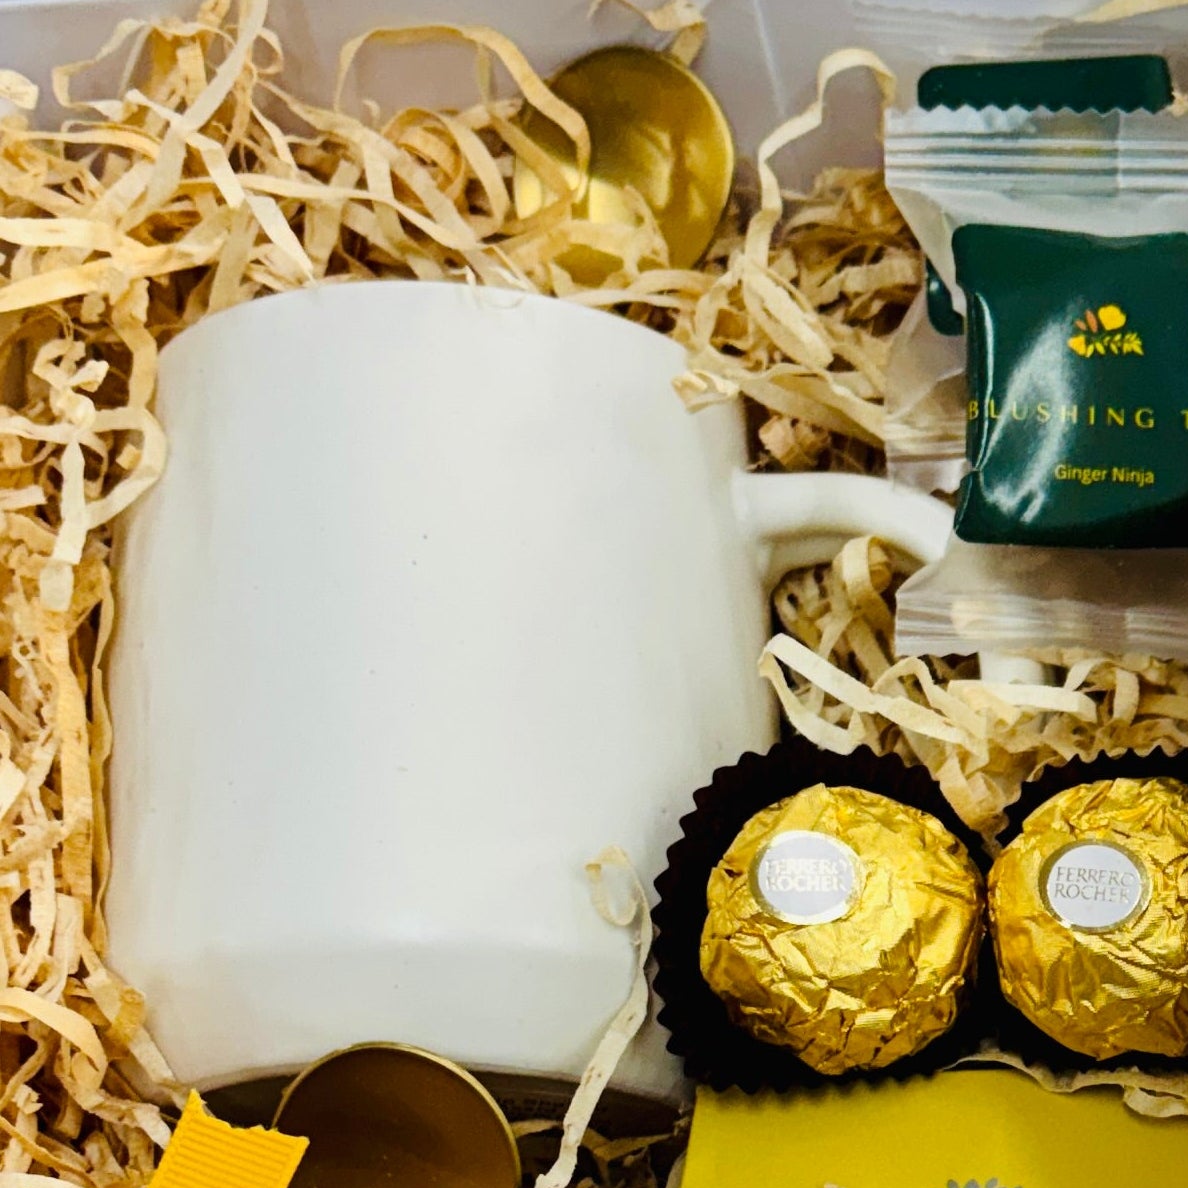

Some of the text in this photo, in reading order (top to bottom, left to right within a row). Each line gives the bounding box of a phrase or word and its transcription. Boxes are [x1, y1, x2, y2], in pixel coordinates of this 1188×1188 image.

[967, 399, 1156, 430] BLUSHING
[1054, 464, 1155, 487] Ginger Ninja
[1056, 866, 1136, 886] FERRERO
[1053, 883, 1132, 903] ROCHER
